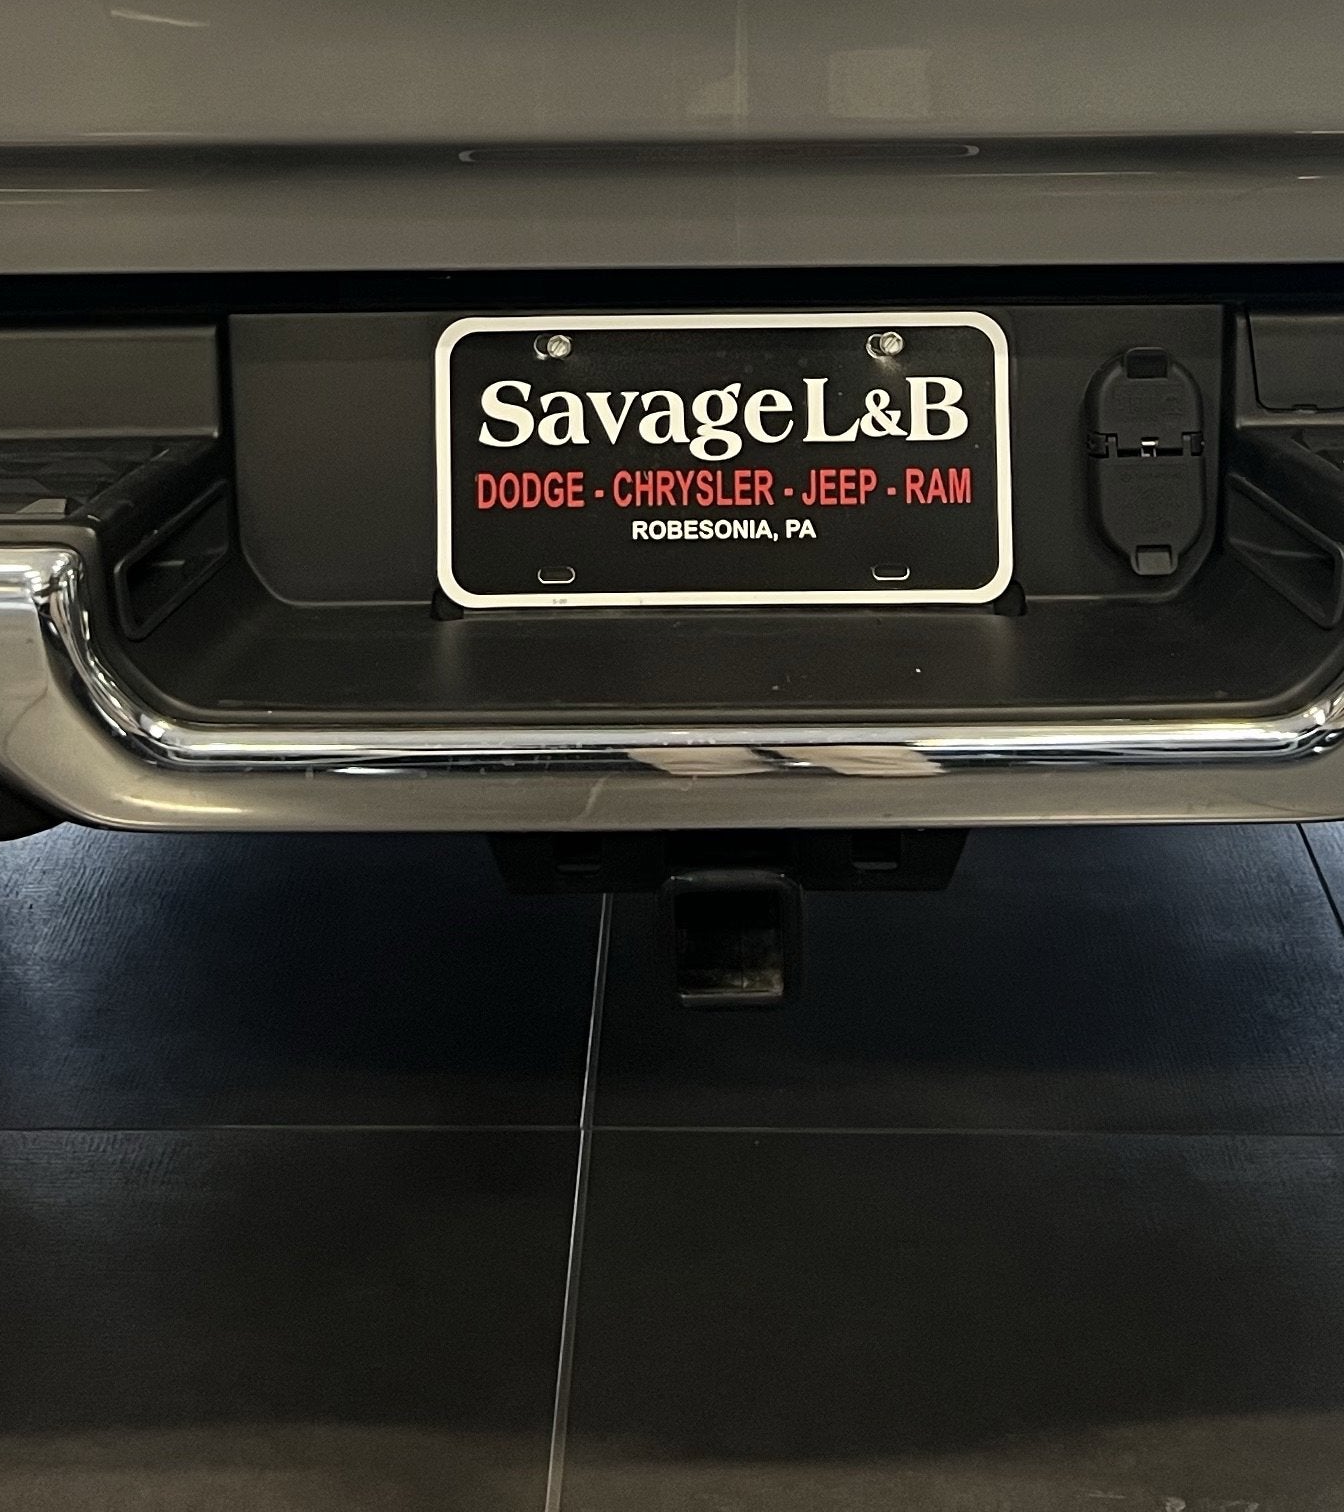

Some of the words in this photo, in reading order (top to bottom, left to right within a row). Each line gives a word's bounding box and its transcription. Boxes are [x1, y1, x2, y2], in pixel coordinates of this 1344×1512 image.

[477, 471, 585, 509] DODGE
[613, 469, 775, 508] CHRYSLER
[801, 468, 878, 506] JEEP
[905, 467, 973, 506] RAM
[631, 519, 779, 543] ROBESONIA,
[785, 518, 818, 541] PA
